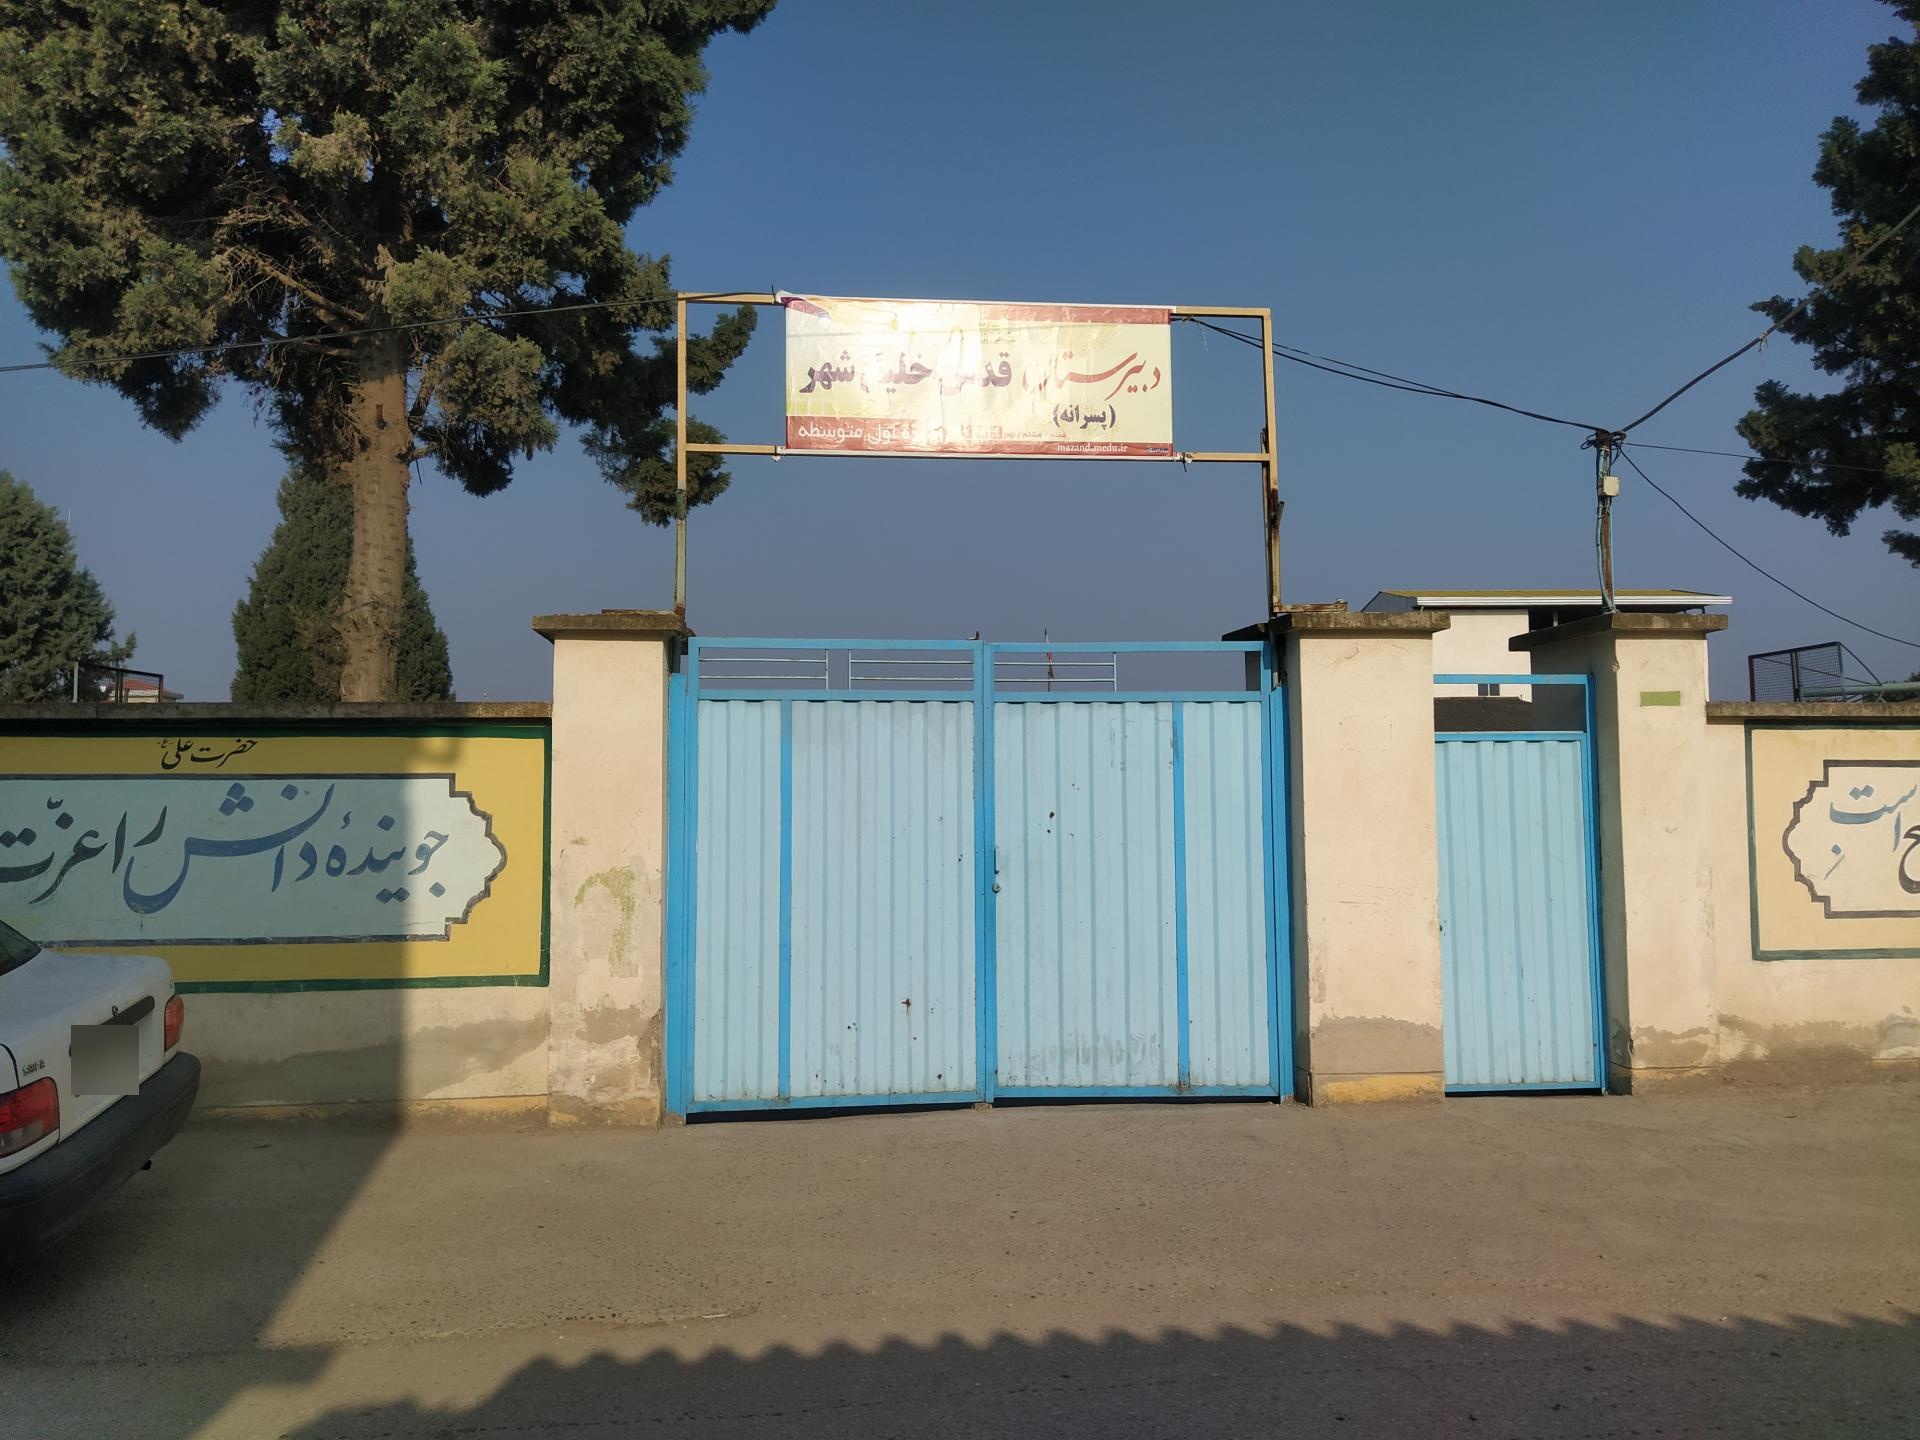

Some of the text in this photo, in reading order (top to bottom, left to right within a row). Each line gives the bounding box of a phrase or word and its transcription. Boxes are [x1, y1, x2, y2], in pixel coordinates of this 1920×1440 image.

[799, 349, 856, 394] شهر
[1053, 403, 1117, 430] (پسرانه)
[798, 422, 863, 443] متوسطه
[1056, 442, 1128, 454] mazand.medu.ir
[191, 738, 258, 769] حضرت
[112, 805, 168, 874] را
[123, 782, 335, 915] دانش
